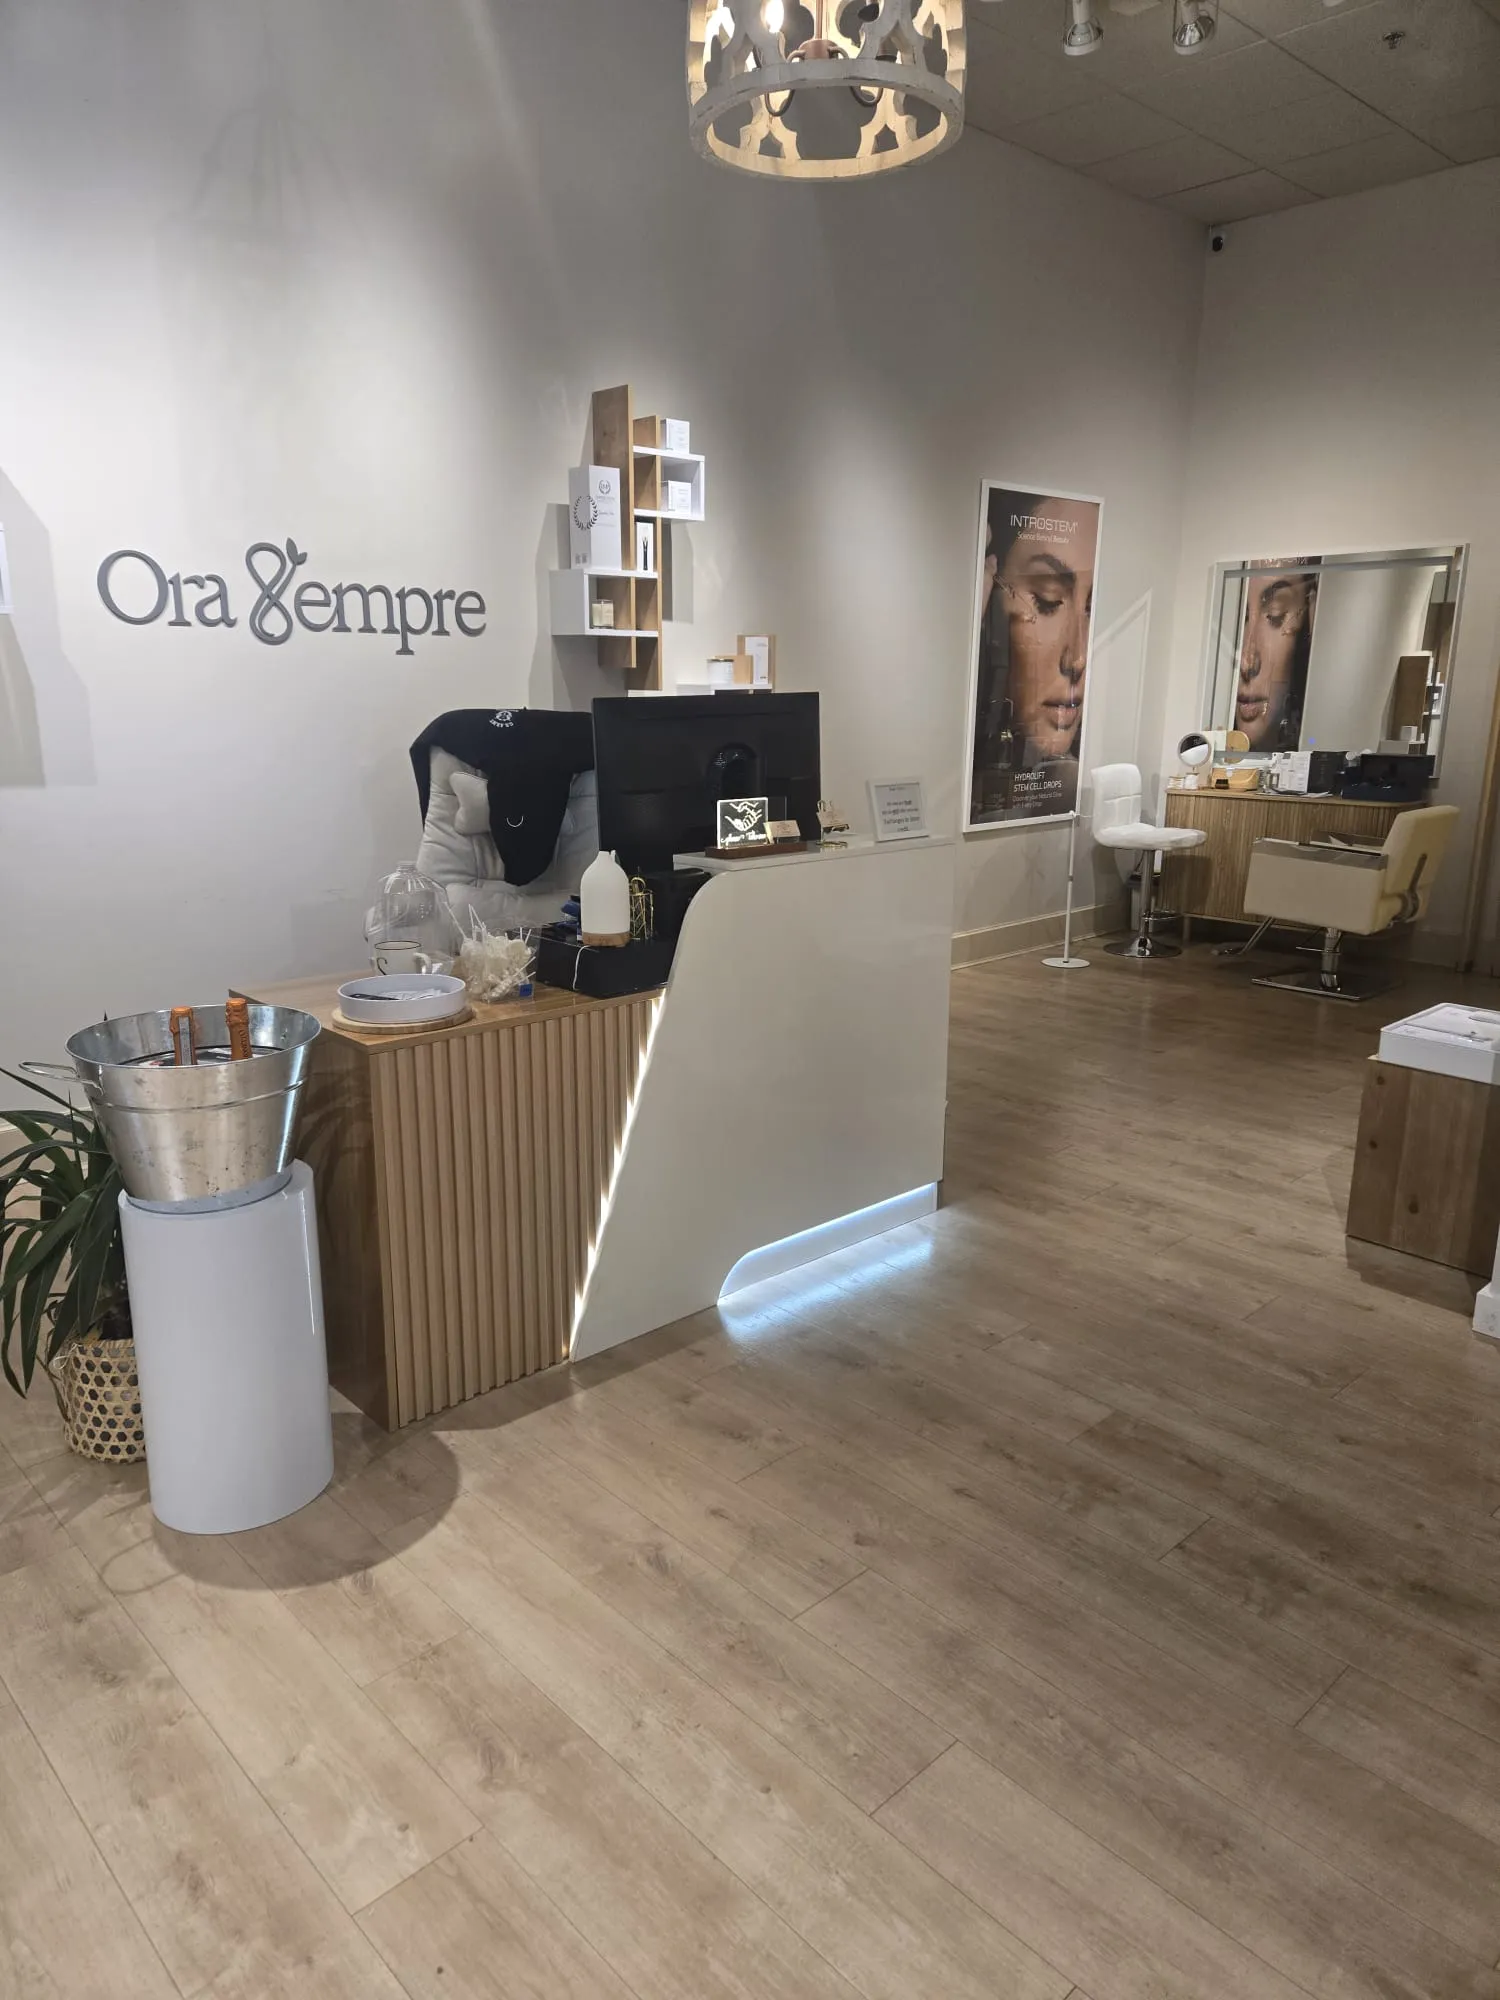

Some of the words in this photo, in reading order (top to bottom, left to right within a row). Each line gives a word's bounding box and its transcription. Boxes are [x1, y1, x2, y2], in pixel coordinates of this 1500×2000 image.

[97, 549, 237, 627] Ora
[1014, 771, 1046, 781] HYDROLIFT
[1013, 783, 1029, 792] STEM
[1029, 782, 1043, 791] CELL
[1043, 780, 1062, 790] DROPS
